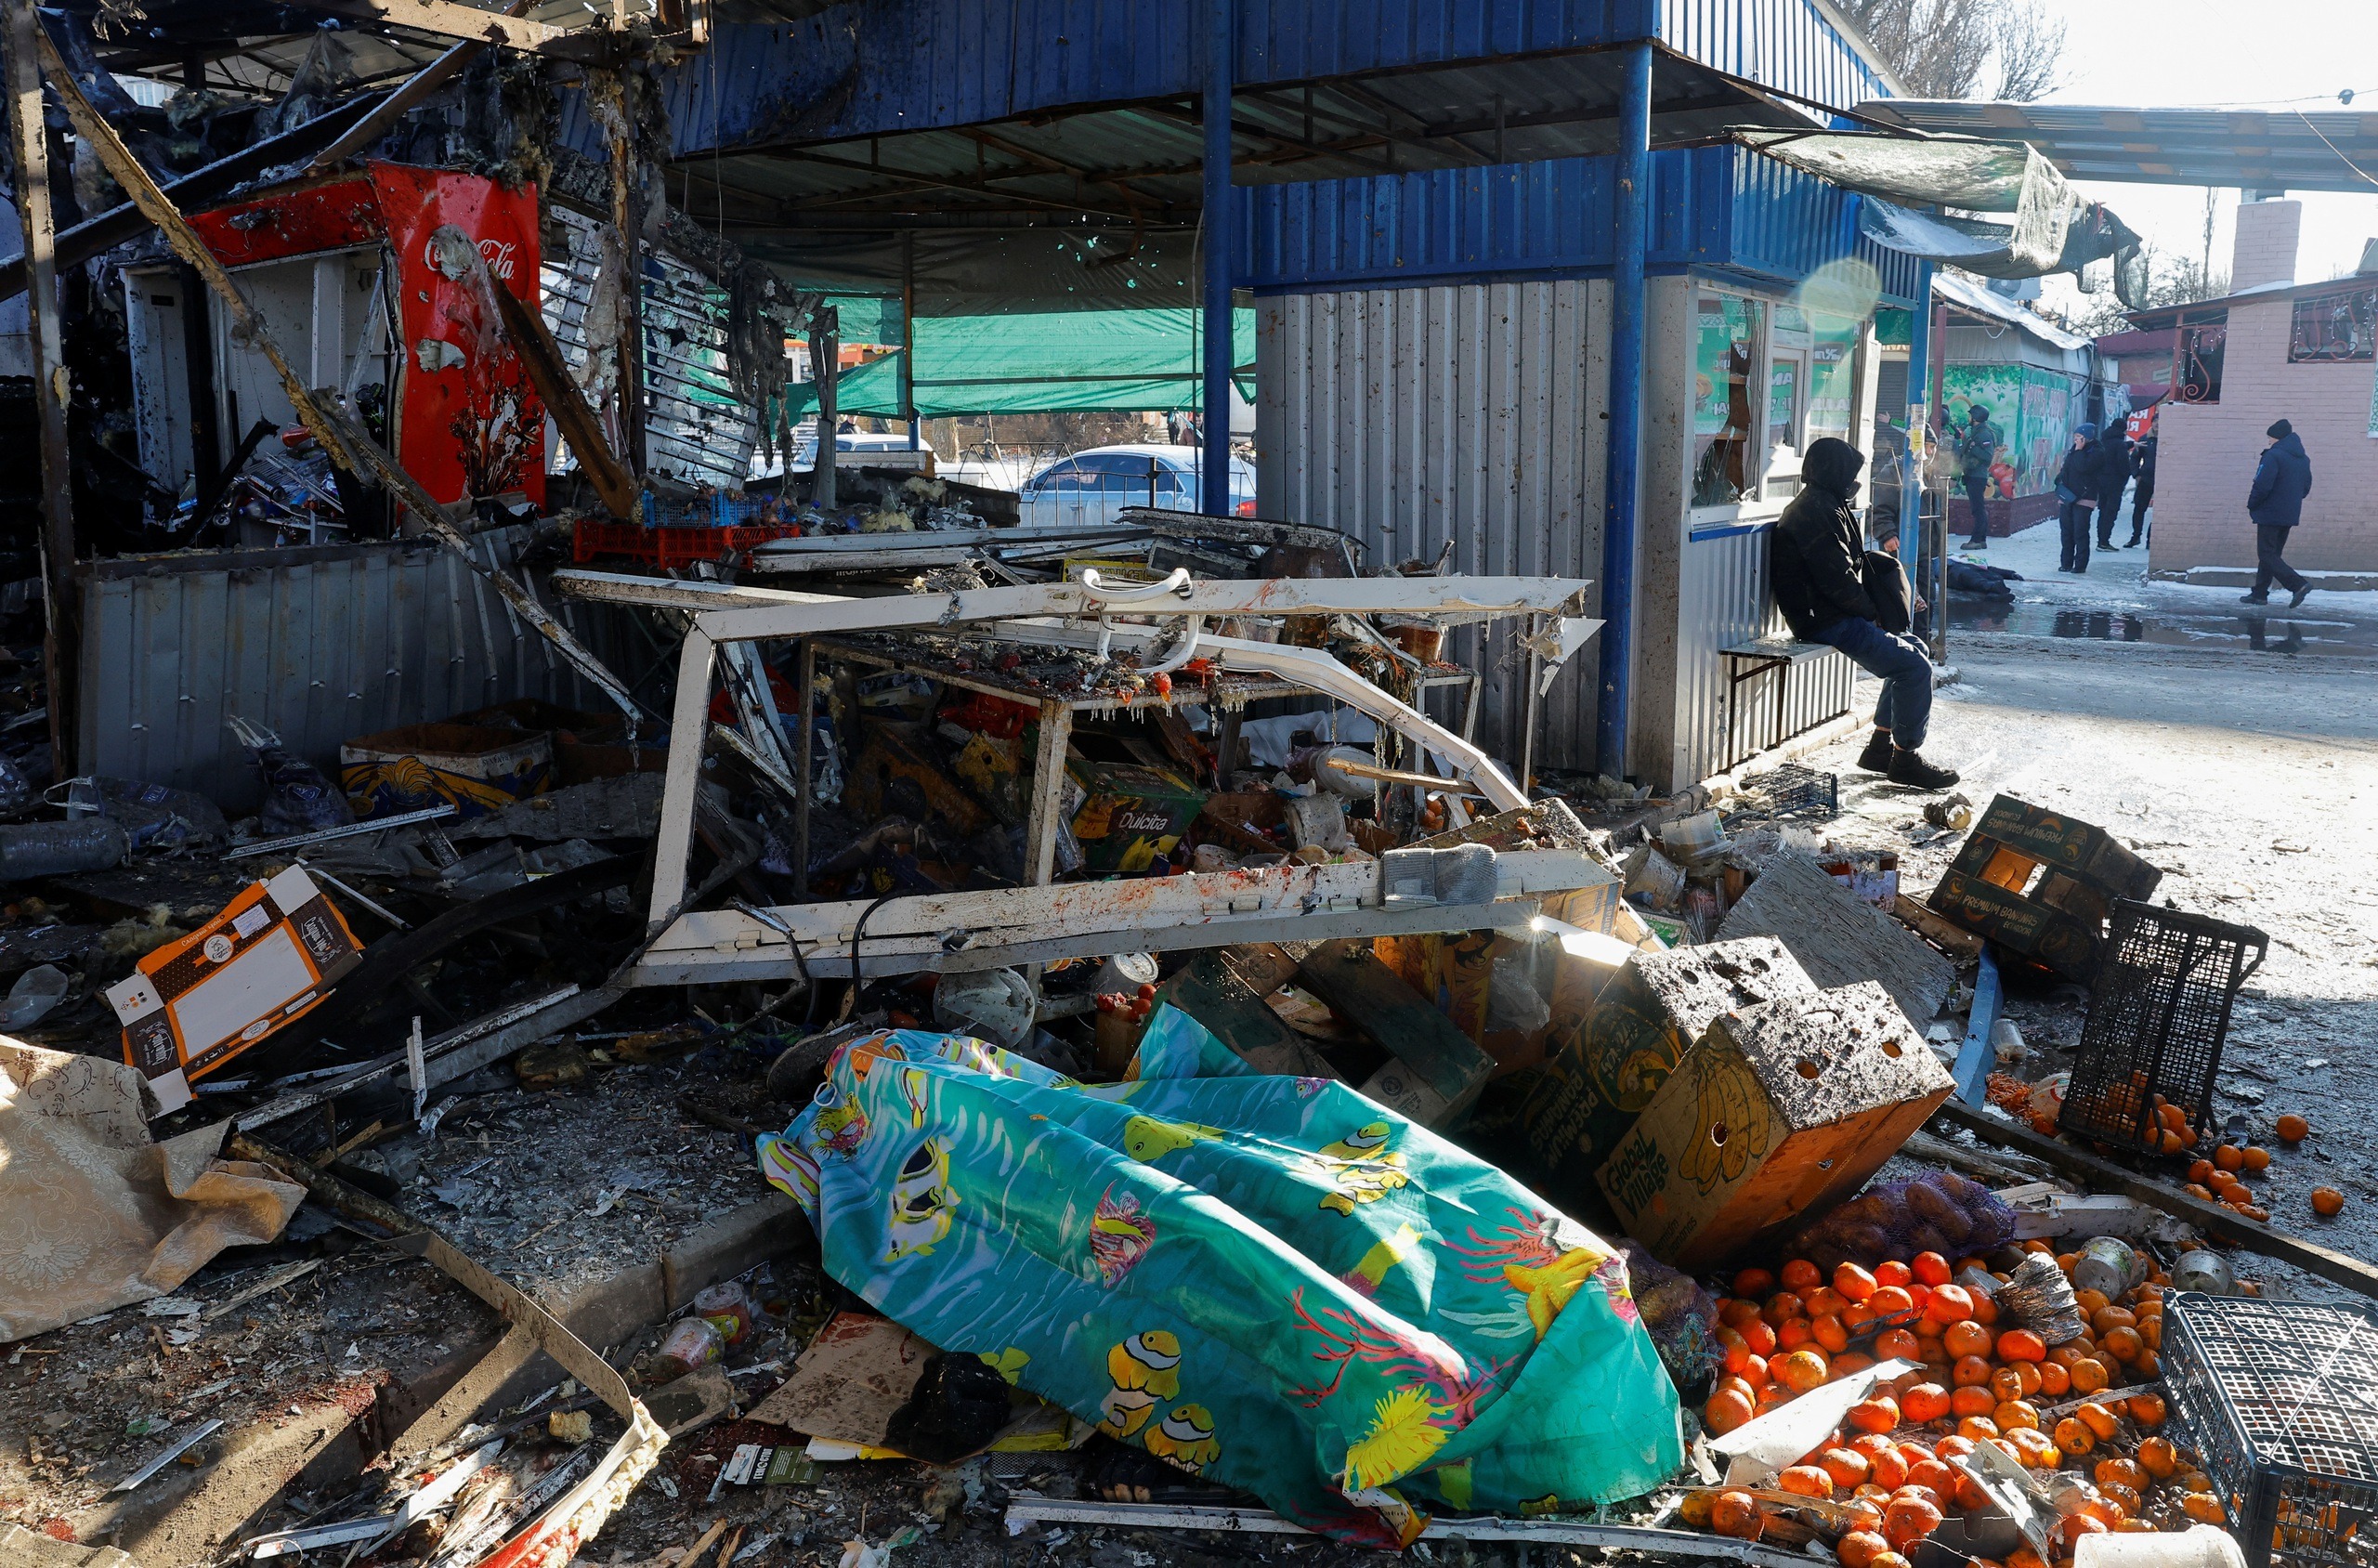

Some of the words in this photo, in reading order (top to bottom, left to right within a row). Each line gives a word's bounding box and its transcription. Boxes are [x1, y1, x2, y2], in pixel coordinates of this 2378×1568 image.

[1118, 812, 1168, 830] Dulcita
[2023, 826, 2064, 843] PREMIUM
[1962, 895, 2001, 915] PREMIUM
[2000, 907, 2039, 927] BANANAS
[181, 927, 207, 947] Сладкий
[1529, 1068, 1584, 1151] BANANAS
[1547, 1085, 1599, 1169] PREMIUM
[1607, 1126, 1649, 1196] Global
[1619, 1153, 1669, 1222] Village
